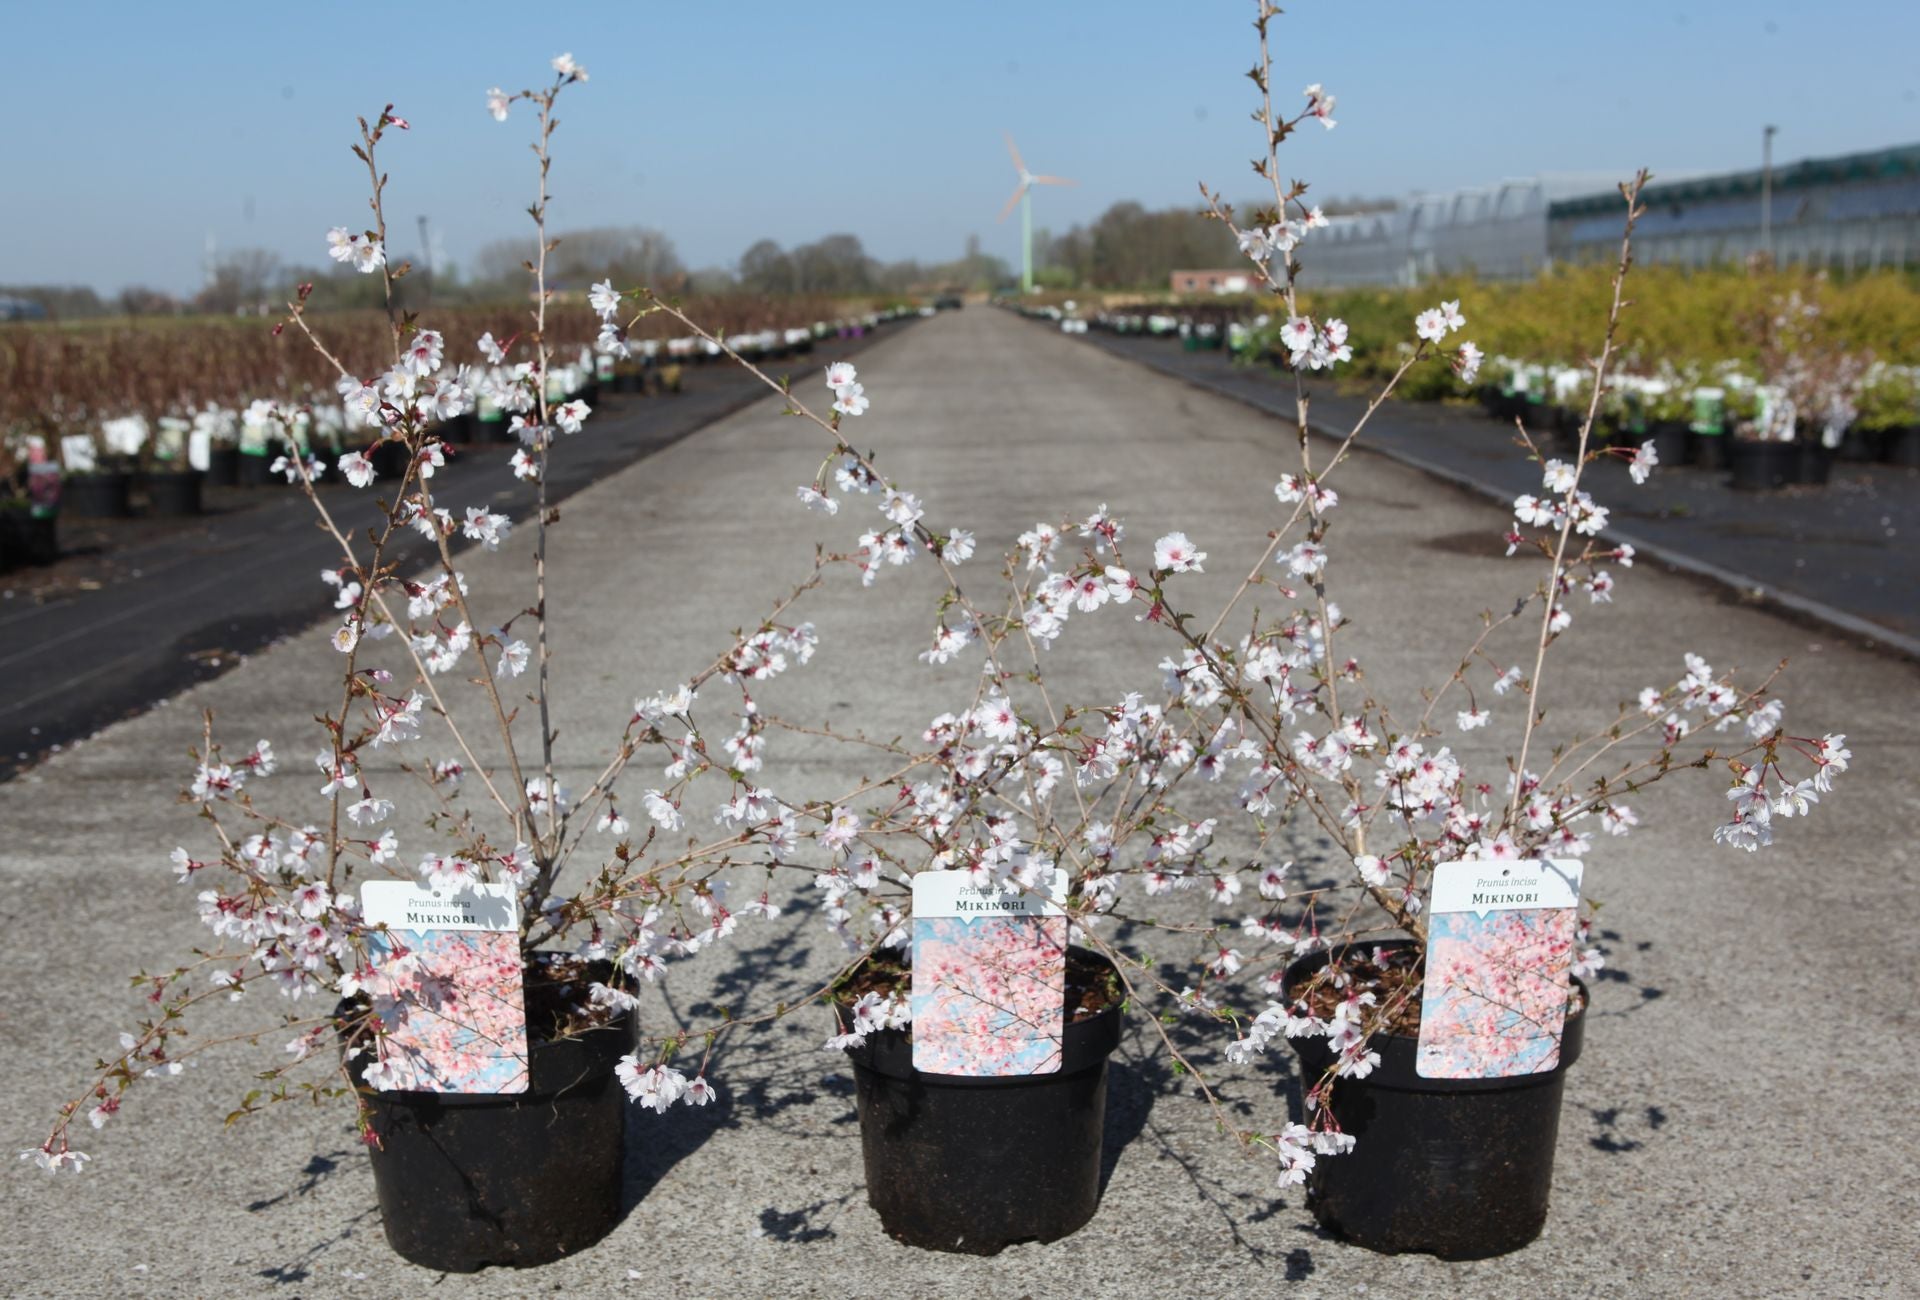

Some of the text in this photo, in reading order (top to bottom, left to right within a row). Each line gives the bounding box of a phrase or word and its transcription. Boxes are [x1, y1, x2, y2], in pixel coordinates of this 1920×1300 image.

[1476, 876, 1538, 888] Prunus incisa
[959, 886, 994, 896] Prunus
[408, 898, 471, 909] Prunus incisa
[1471, 892, 1539, 905] MIKINORI
[956, 900, 1026, 912] MIKINORI
[407, 912, 476, 924] MIKINORI
